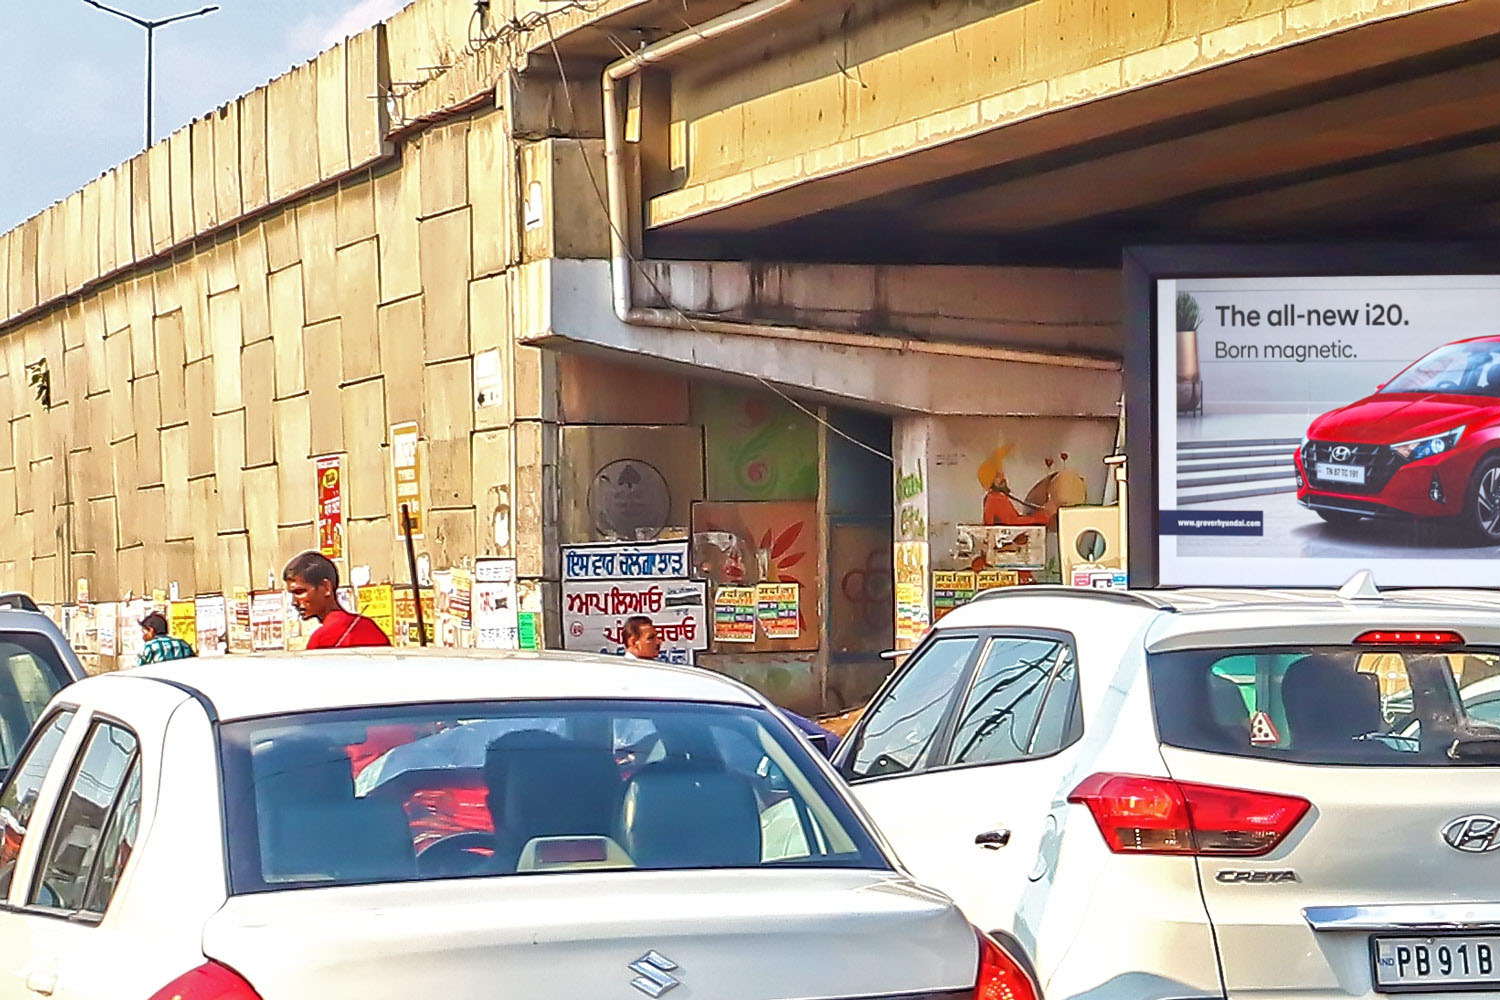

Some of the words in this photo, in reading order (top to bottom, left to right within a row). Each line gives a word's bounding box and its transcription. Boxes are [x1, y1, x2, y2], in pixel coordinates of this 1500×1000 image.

[1215, 305, 1260, 327] The
[1267, 304, 1359, 327] all-new
[1365, 303, 1409, 326] i20.
[1215, 341, 1259, 359] Born
[1263, 340, 1358, 363] magnetic.
[1177, 519, 1261, 528] www.groverhyundai.com
[592, 553, 617, 577] ਵਾਰ
[566, 593, 608, 615] ਆਪ
[1215, 870, 1297, 883] CRETA
